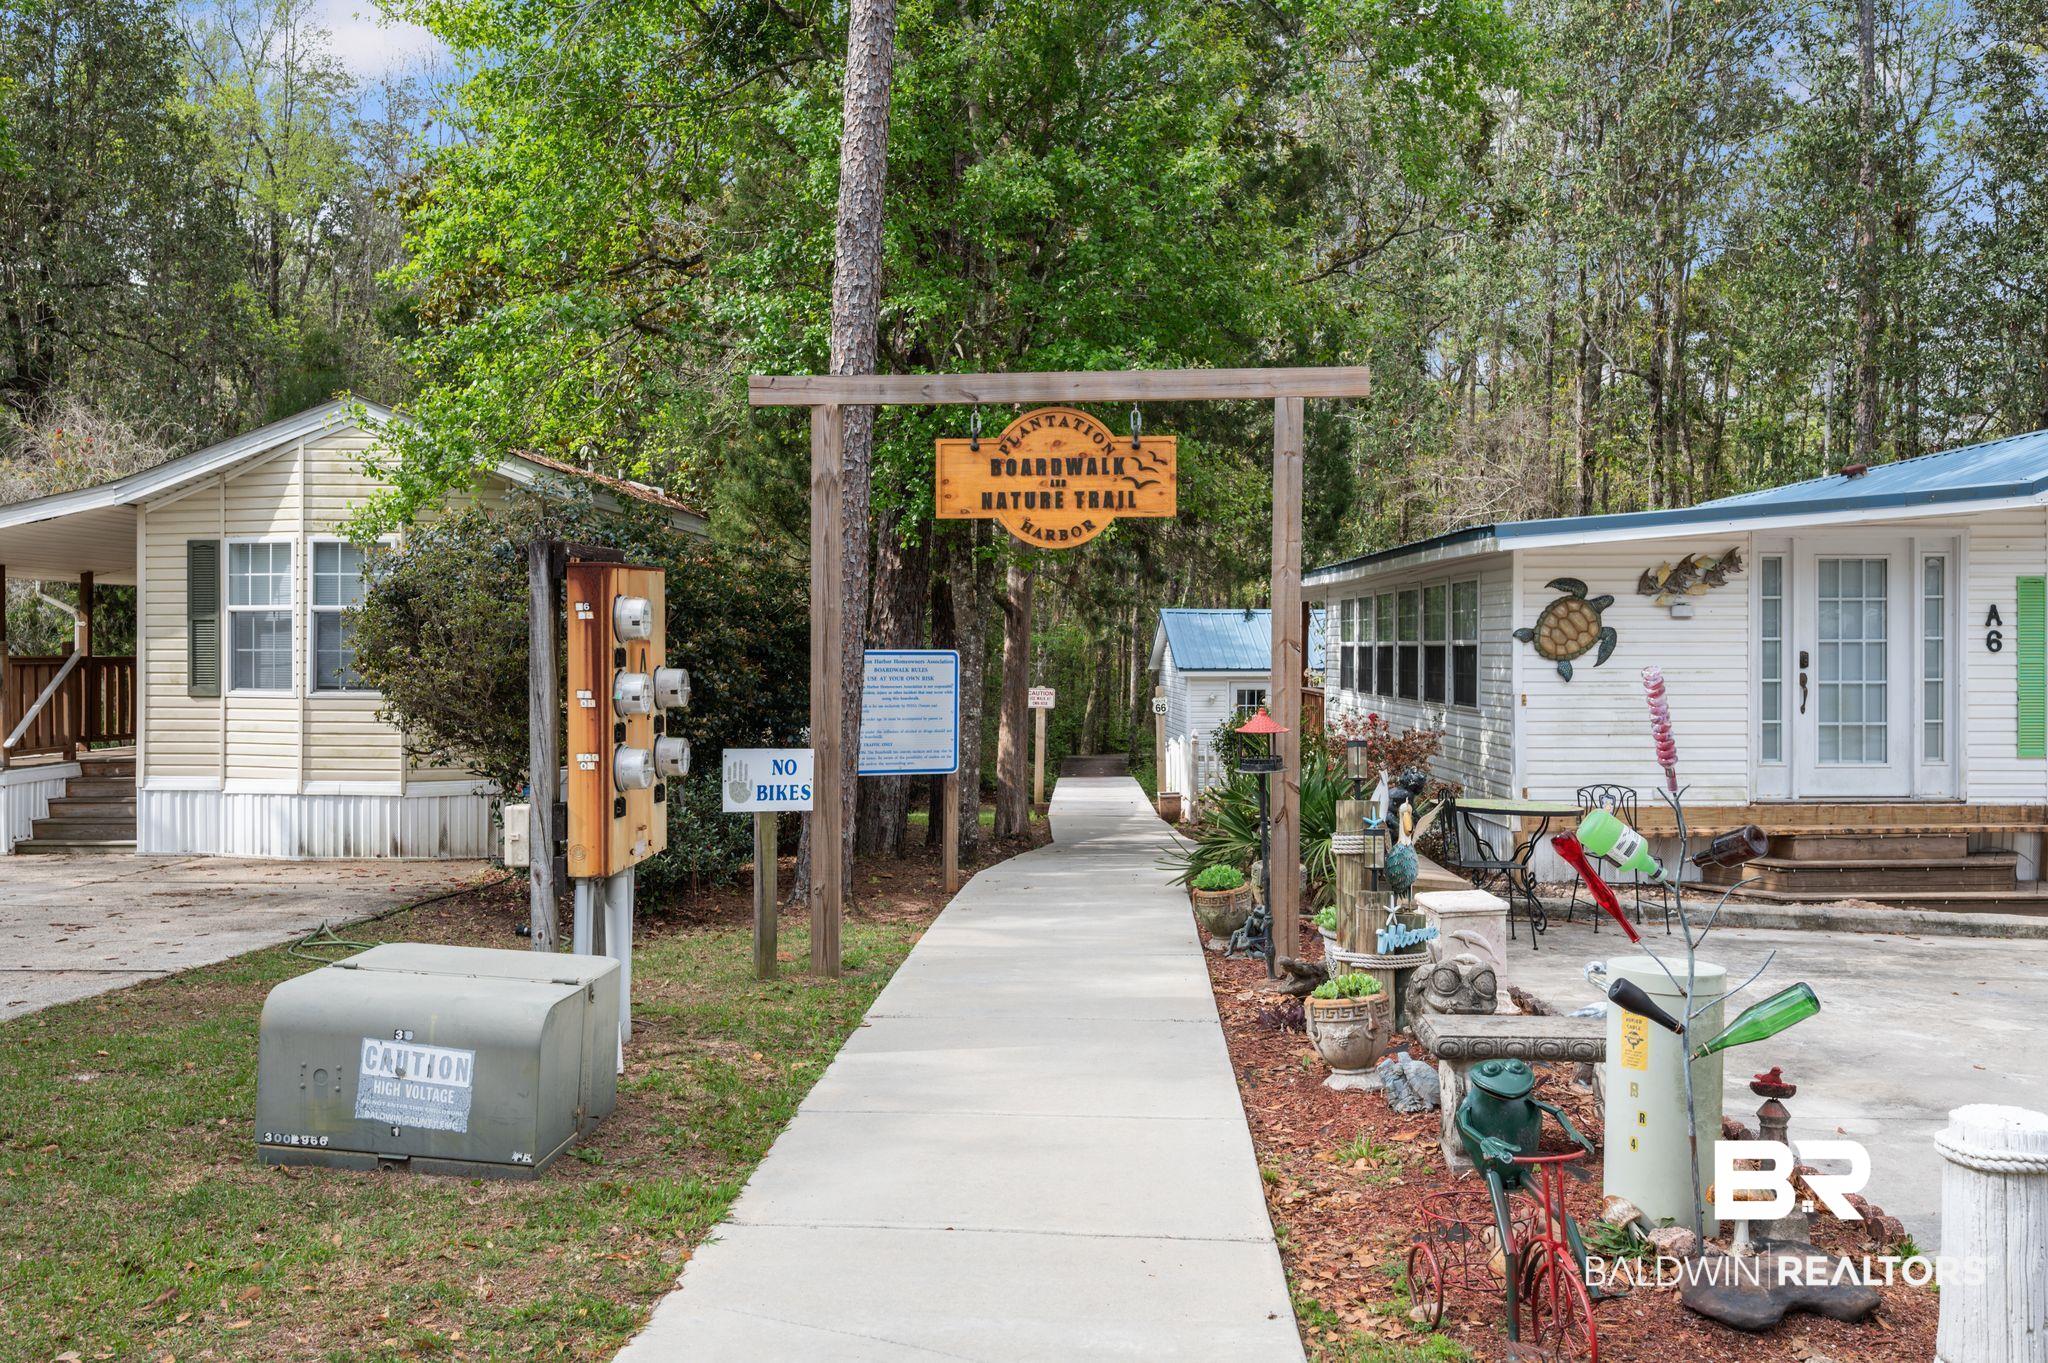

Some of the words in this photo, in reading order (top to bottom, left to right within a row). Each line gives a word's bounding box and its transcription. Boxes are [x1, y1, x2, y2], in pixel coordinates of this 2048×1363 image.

[998, 414, 1116, 457] PLANTATION
[990, 457, 1126, 476] BOARDWALK
[1049, 478, 1067, 488] AND
[981, 490, 1064, 510] NATURE
[1074, 490, 1137, 510] TRAIL
[1018, 518, 1097, 542] HARBOR
[1155, 703, 1166, 712] 66
[772, 759, 797, 776] NO
[756, 784, 811, 801] BIKES
[364, 1045, 469, 1083] CAUTION
[373, 1079, 401, 1098] HIGH
[405, 1084, 455, 1104] VOLTAGE
[1630, 1138, 1636, 1150] 4
